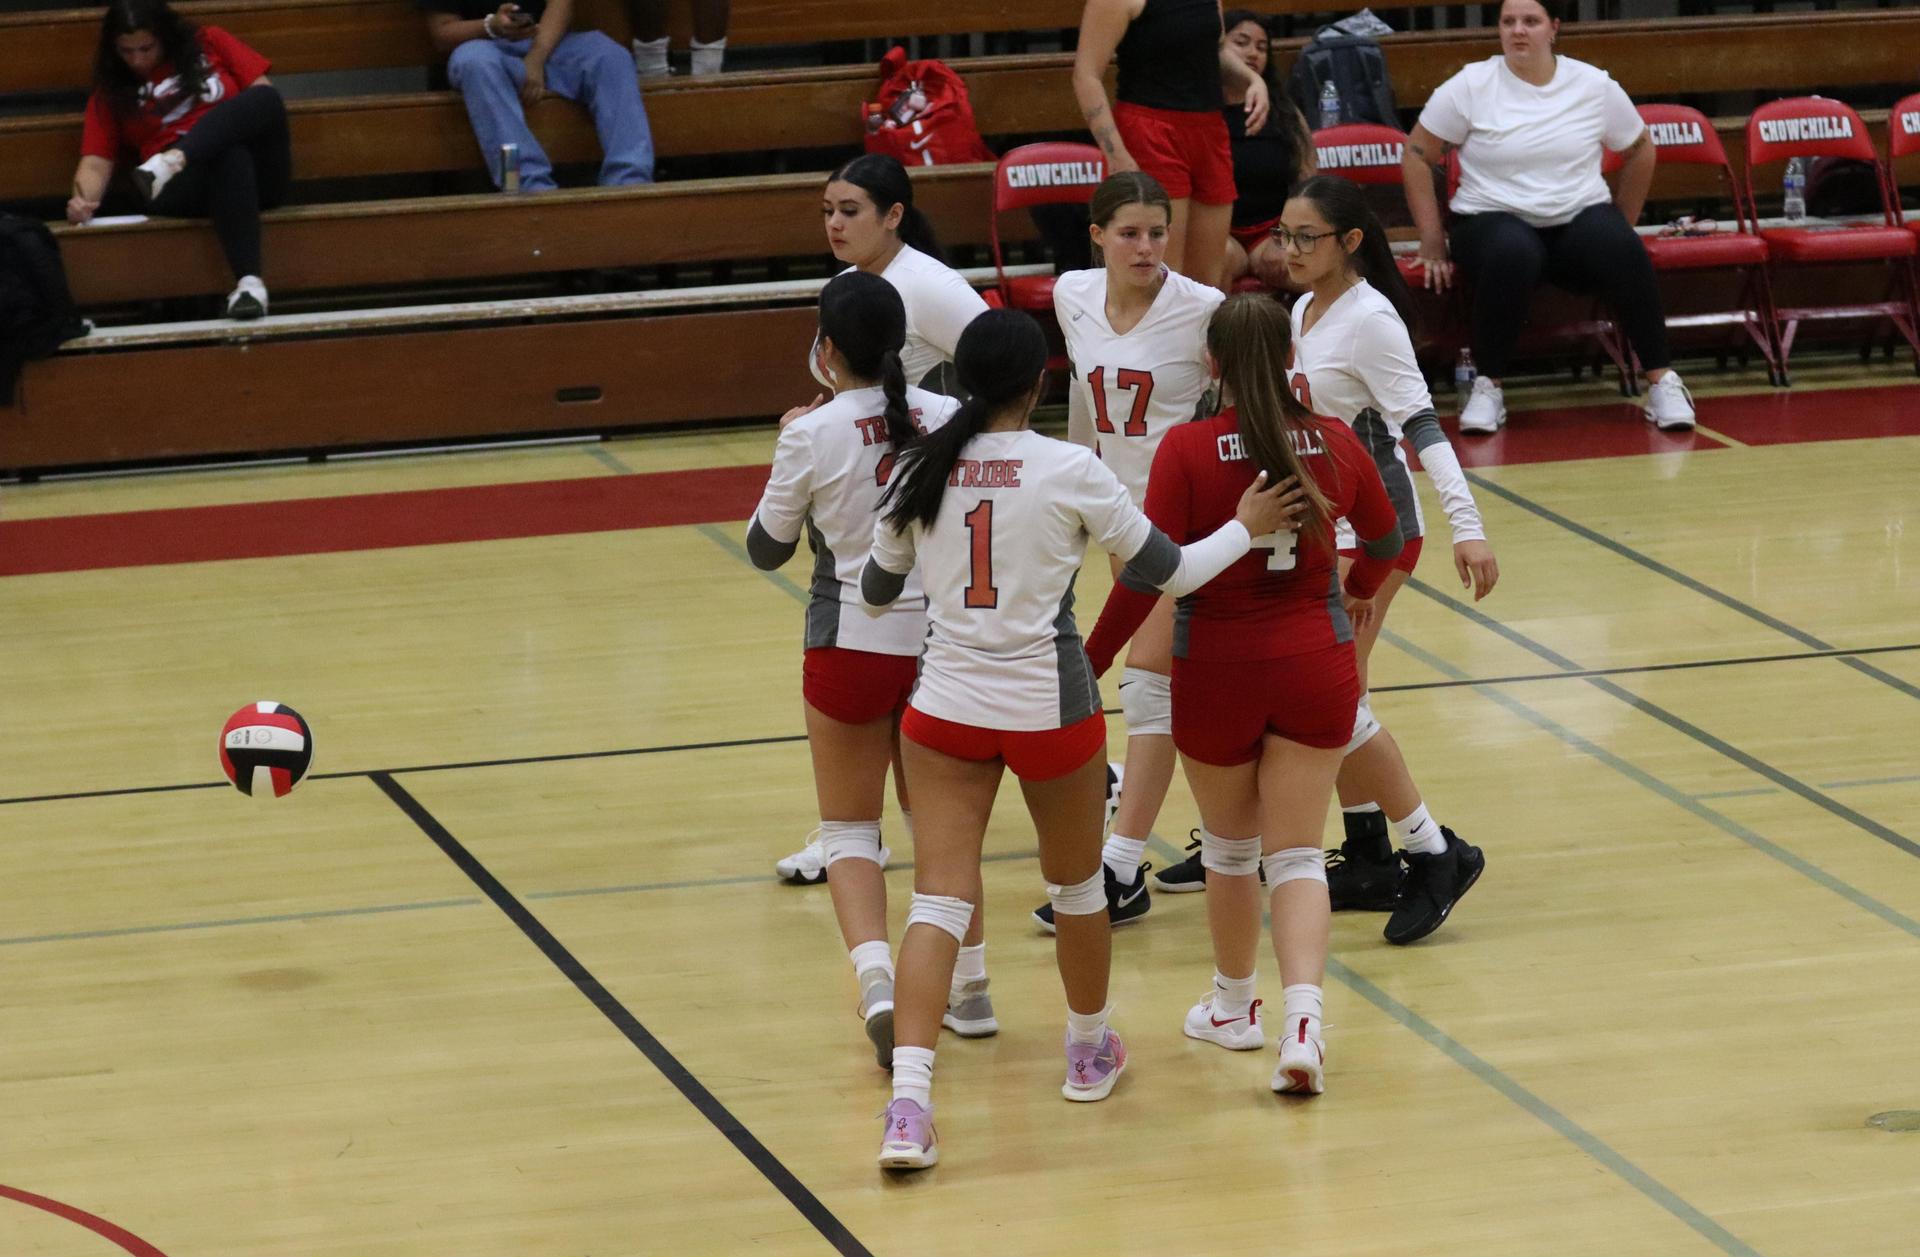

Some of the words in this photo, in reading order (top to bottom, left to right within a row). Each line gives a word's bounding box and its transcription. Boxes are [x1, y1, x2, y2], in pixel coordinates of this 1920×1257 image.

[1649, 122, 1704, 145] CHILLA
[1758, 116, 1854, 143] CHOWCHILLA
[1087, 366, 1154, 437] 17
[854, 407, 929, 446] TRE
[949, 458, 1023, 488] TRIBE
[964, 500, 998, 609] 1
